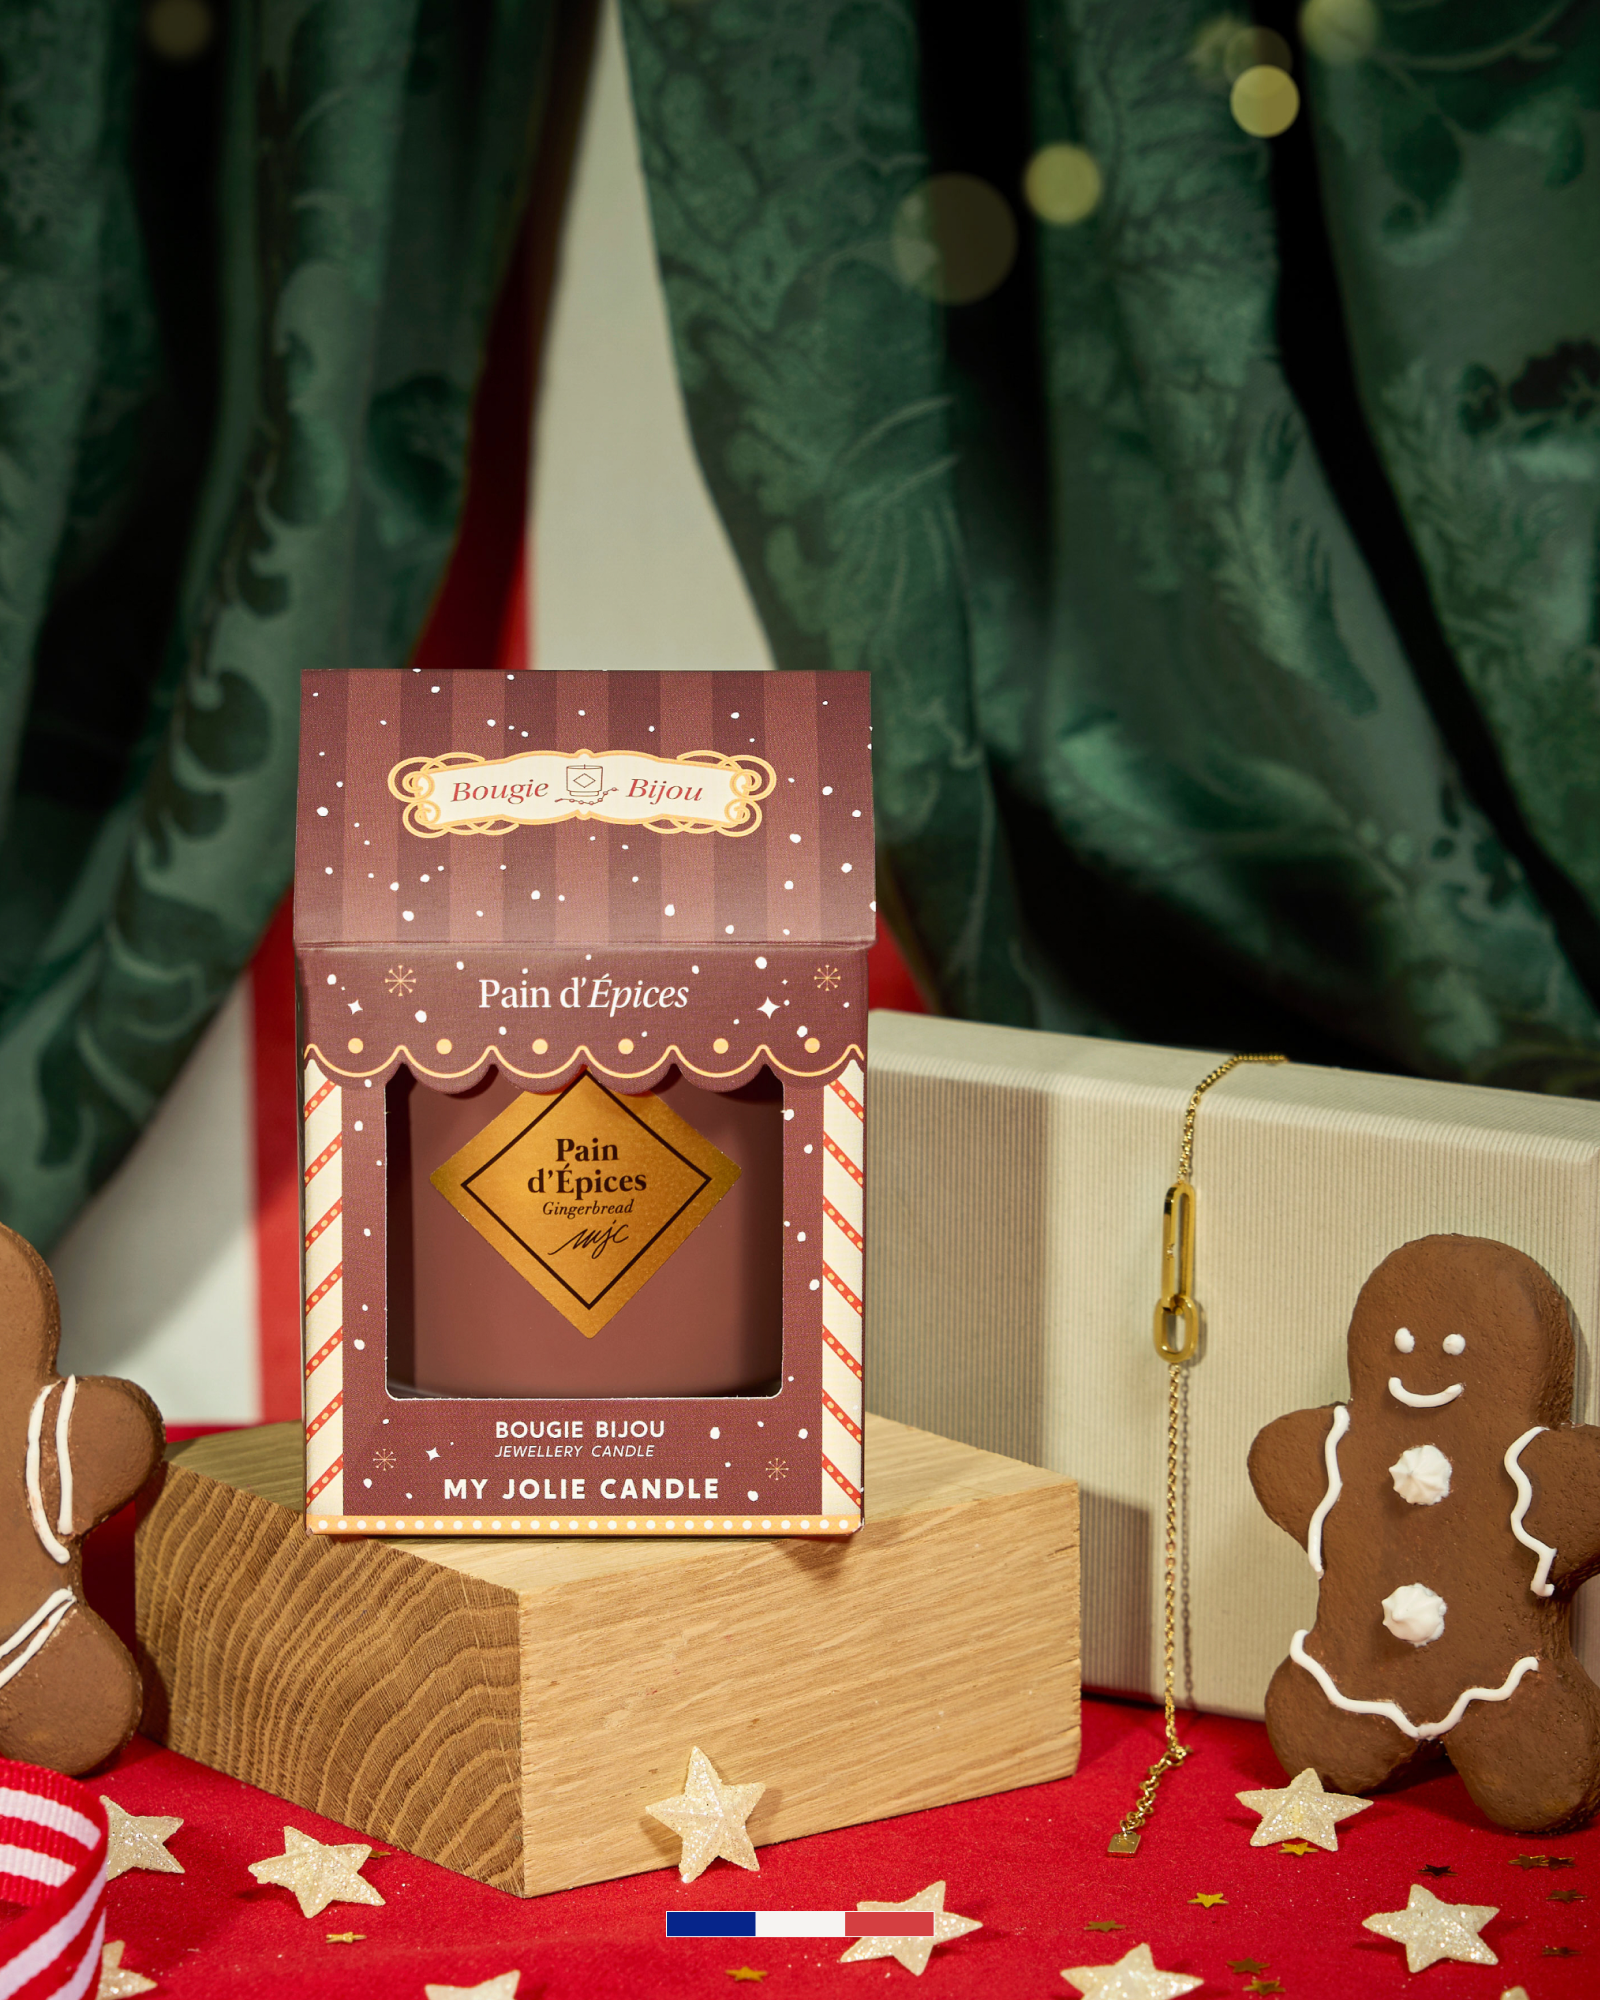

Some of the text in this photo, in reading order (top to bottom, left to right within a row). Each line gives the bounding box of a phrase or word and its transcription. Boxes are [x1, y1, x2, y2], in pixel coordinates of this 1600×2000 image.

[450, 778, 704, 805] Bougie Bijou
[478, 972, 690, 1018] Pain d'Épices
[555, 1137, 620, 1162] Pain
[527, 1162, 648, 1201] d'Épices
[542, 1198, 635, 1220] Gingerbread
[495, 1420, 666, 1439] BOUGIE BIJOU
[494, 1444, 656, 1458] JEWELLERY CANDLE
[444, 1478, 720, 1500] MY JOLIE CANDLE
